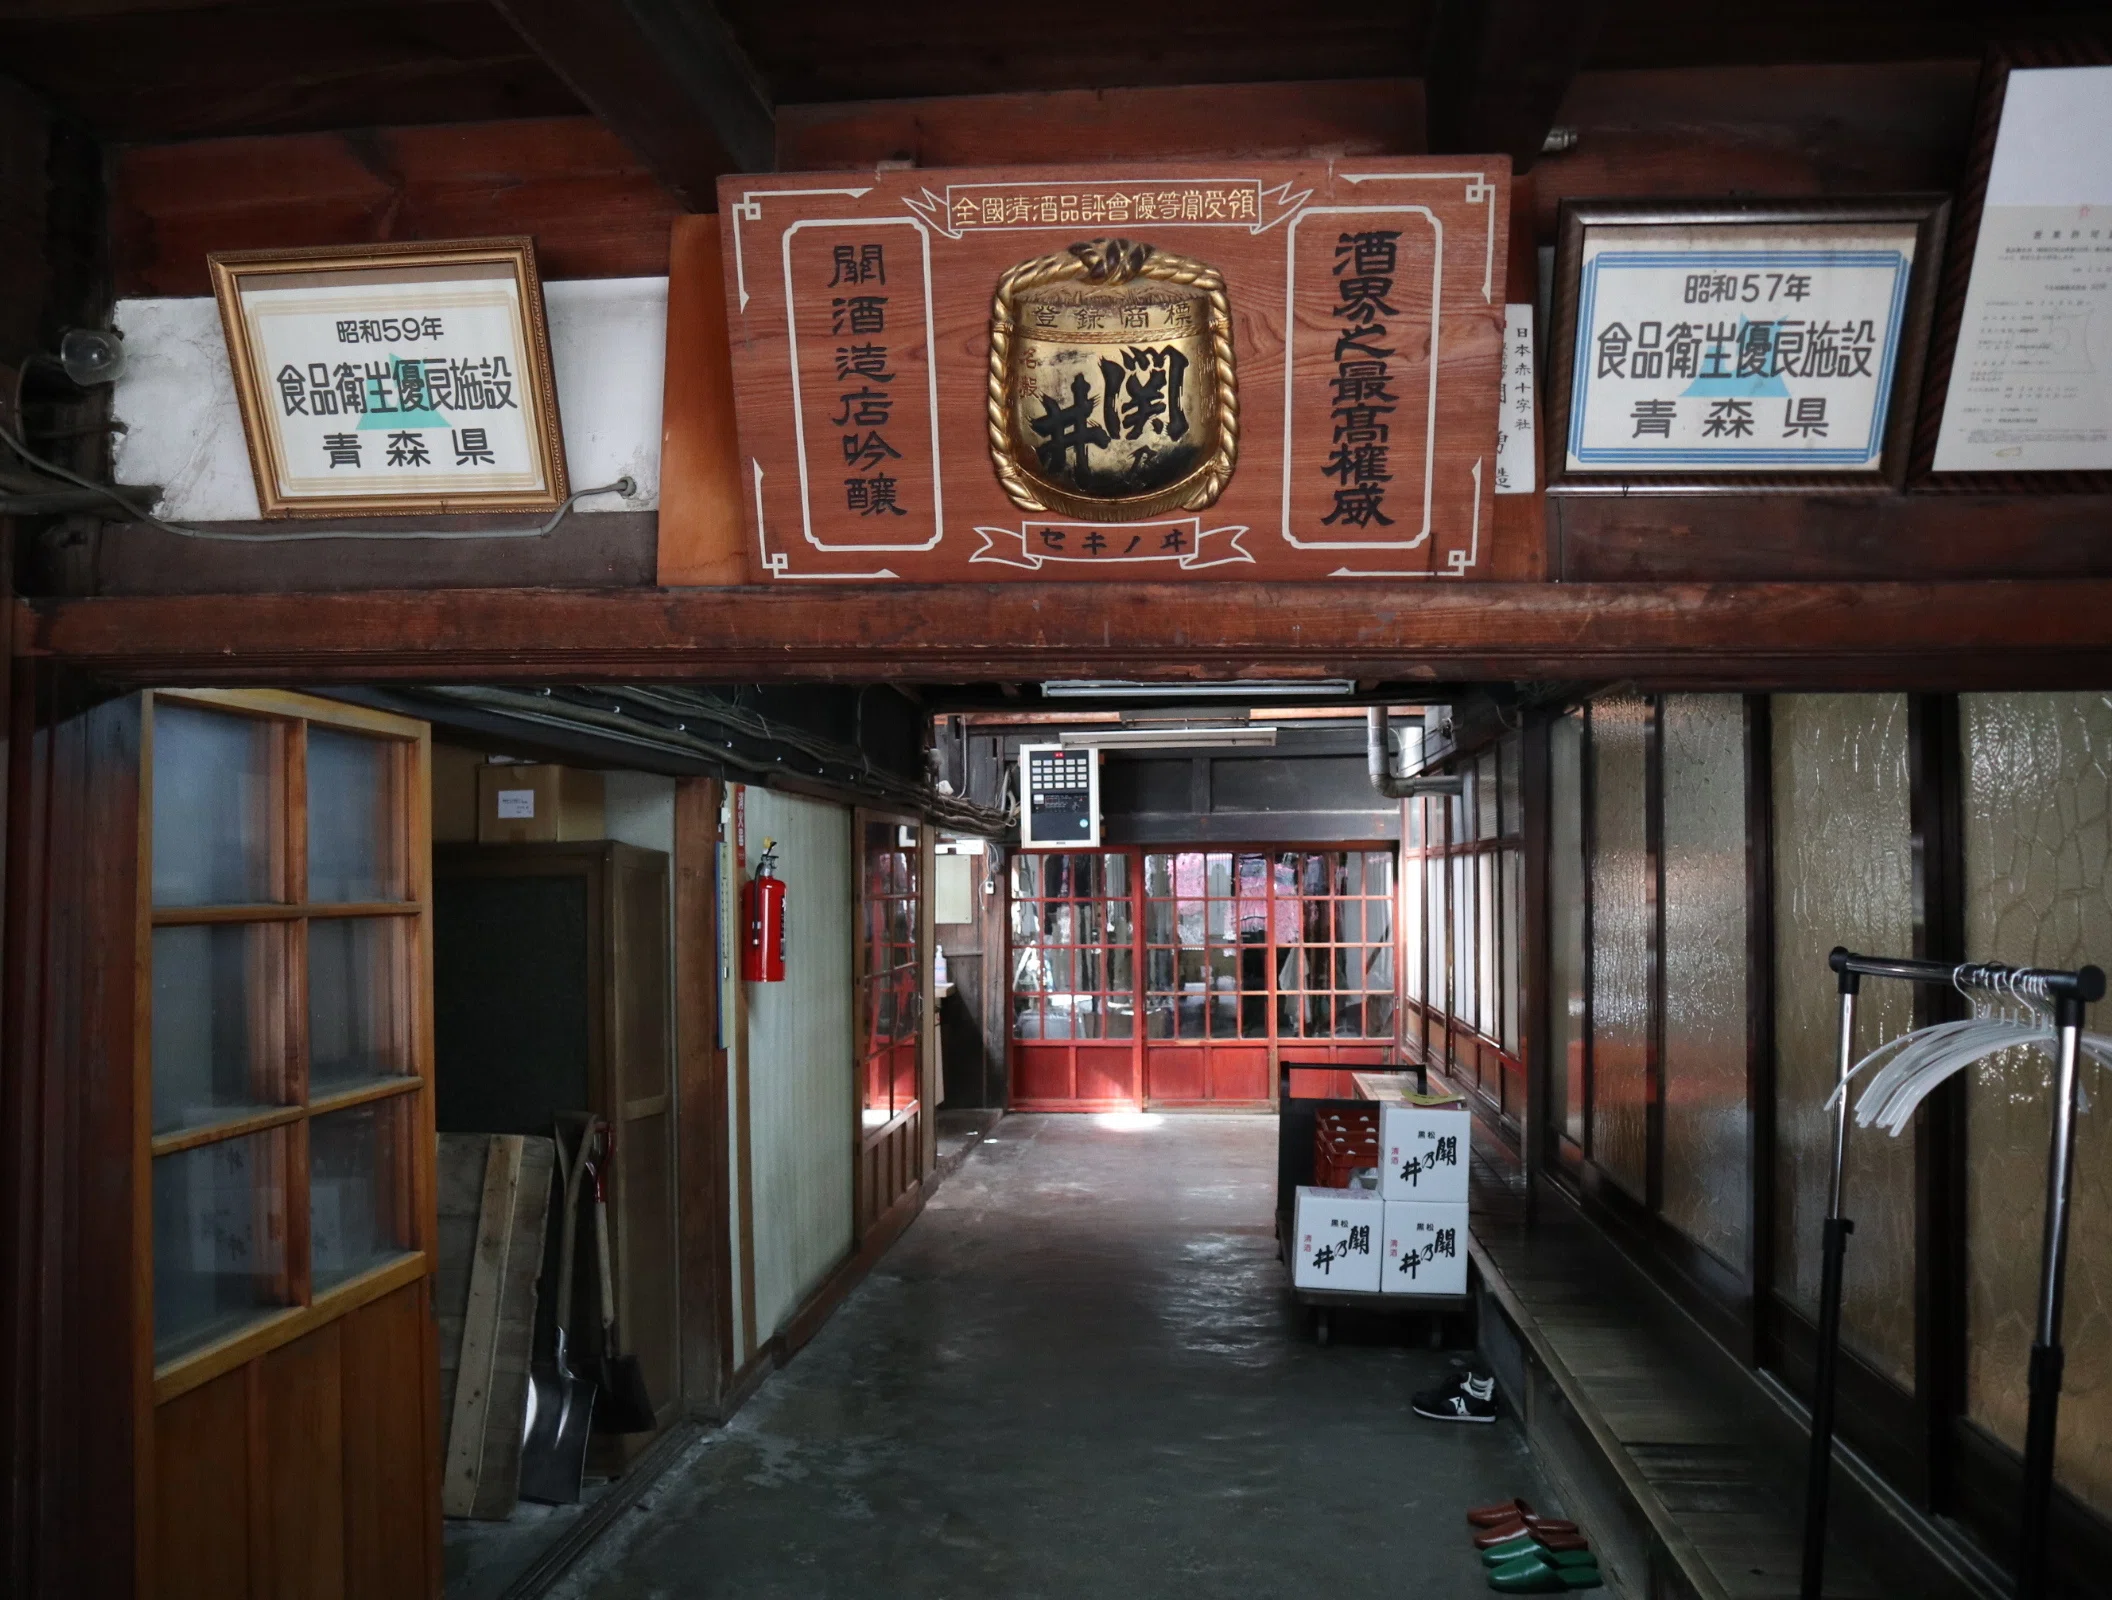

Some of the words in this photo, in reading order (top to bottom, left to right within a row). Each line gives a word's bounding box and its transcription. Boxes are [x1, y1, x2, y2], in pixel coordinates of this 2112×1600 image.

[1684, 273, 1812, 303] 昭和57年
[335, 316, 444, 343] 昭和59年
[1597, 320, 1876, 379] 食品衛生優良施設
[276, 356, 518, 416] 食品衛生優良施設
[1514, 327, 1532, 431] 日本赤十字社
[1630, 398, 1829, 438] 青森県
[322, 428, 496, 469] 青森県
